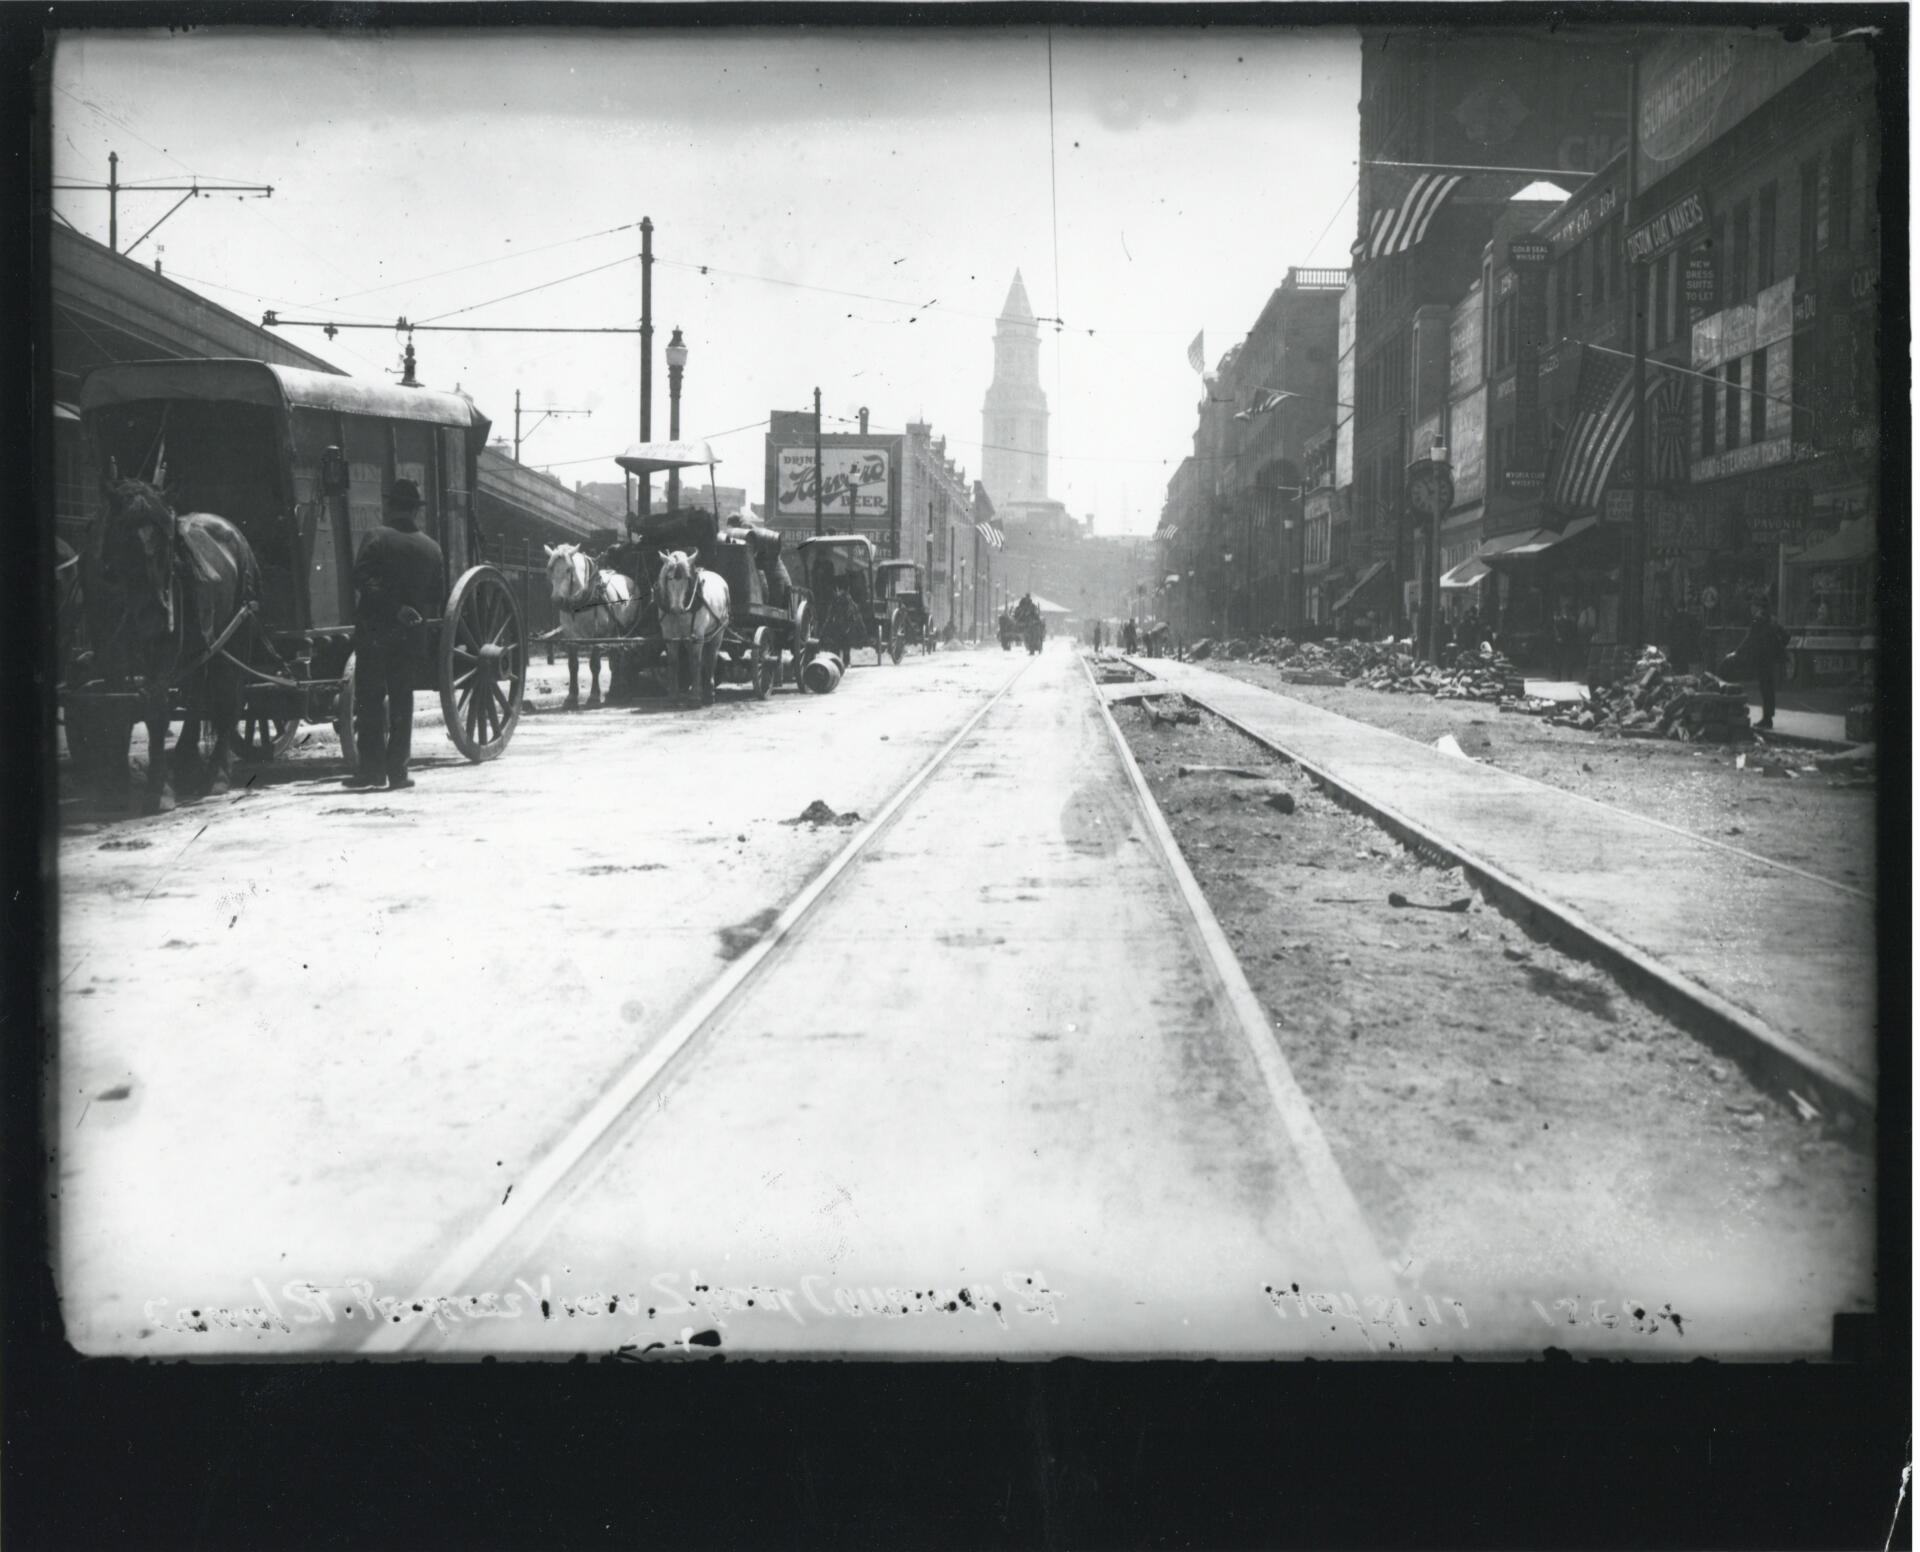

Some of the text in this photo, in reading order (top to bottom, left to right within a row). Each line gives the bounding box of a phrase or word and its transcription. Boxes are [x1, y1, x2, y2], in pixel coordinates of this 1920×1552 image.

[1668, 194, 1703, 237] MAKERS
[1690, 260, 1711, 269] NEW
[1686, 270, 1714, 279] DRESS
[1686, 280, 1713, 289] SUITS
[1685, 291, 1714, 301] TO LET
[784, 455, 824, 466] DRIN
